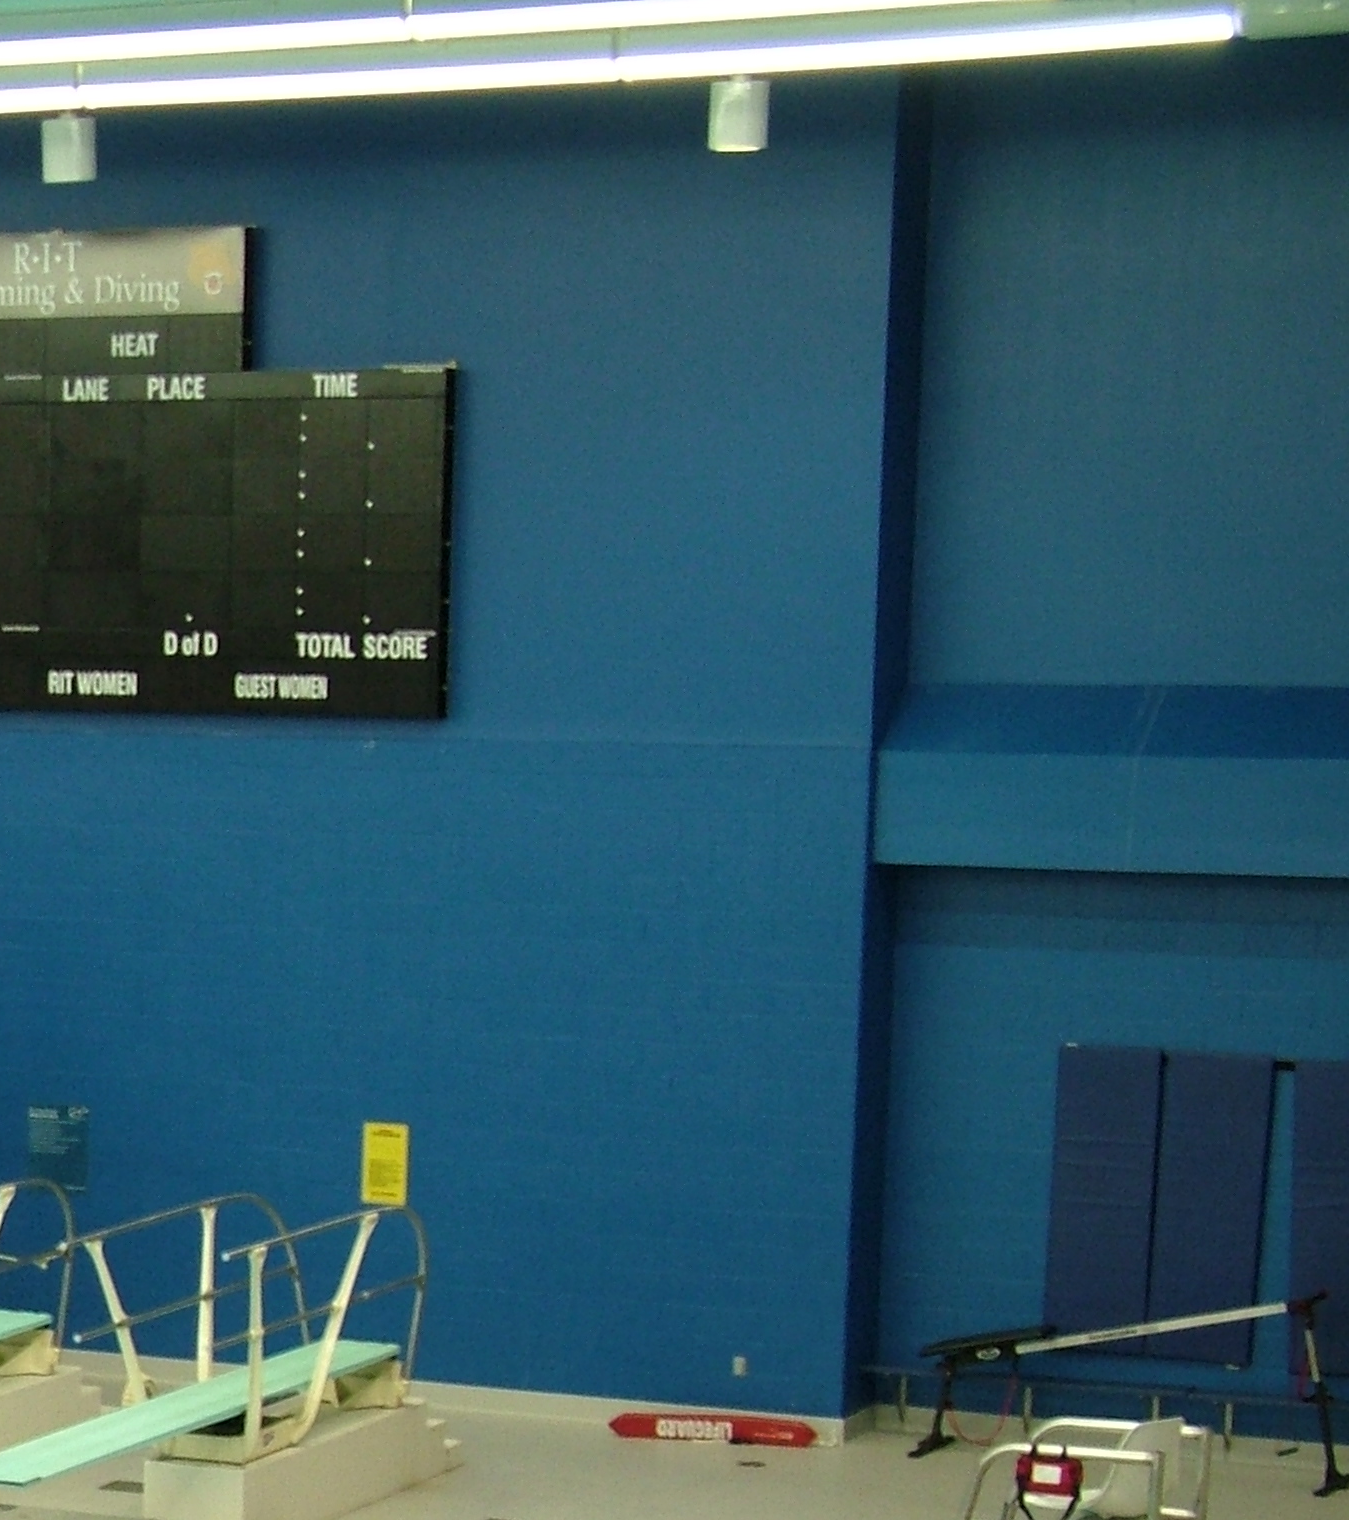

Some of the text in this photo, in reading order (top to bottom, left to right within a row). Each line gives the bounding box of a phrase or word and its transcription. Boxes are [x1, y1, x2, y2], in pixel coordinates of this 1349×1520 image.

[64, 277, 84, 304] &
[95, 273, 180, 311] Diving
[110, 332, 159, 357] HEAT
[62, 378, 109, 402] LANE
[146, 376, 206, 401] PLACE
[312, 373, 358, 398] TIME
[163, 630, 219, 656] D of D
[295, 632, 428, 660] TOTAL SCORE
[47, 669, 138, 697] RIT WOMEN
[234, 672, 328, 700] GUEST WOMEN
